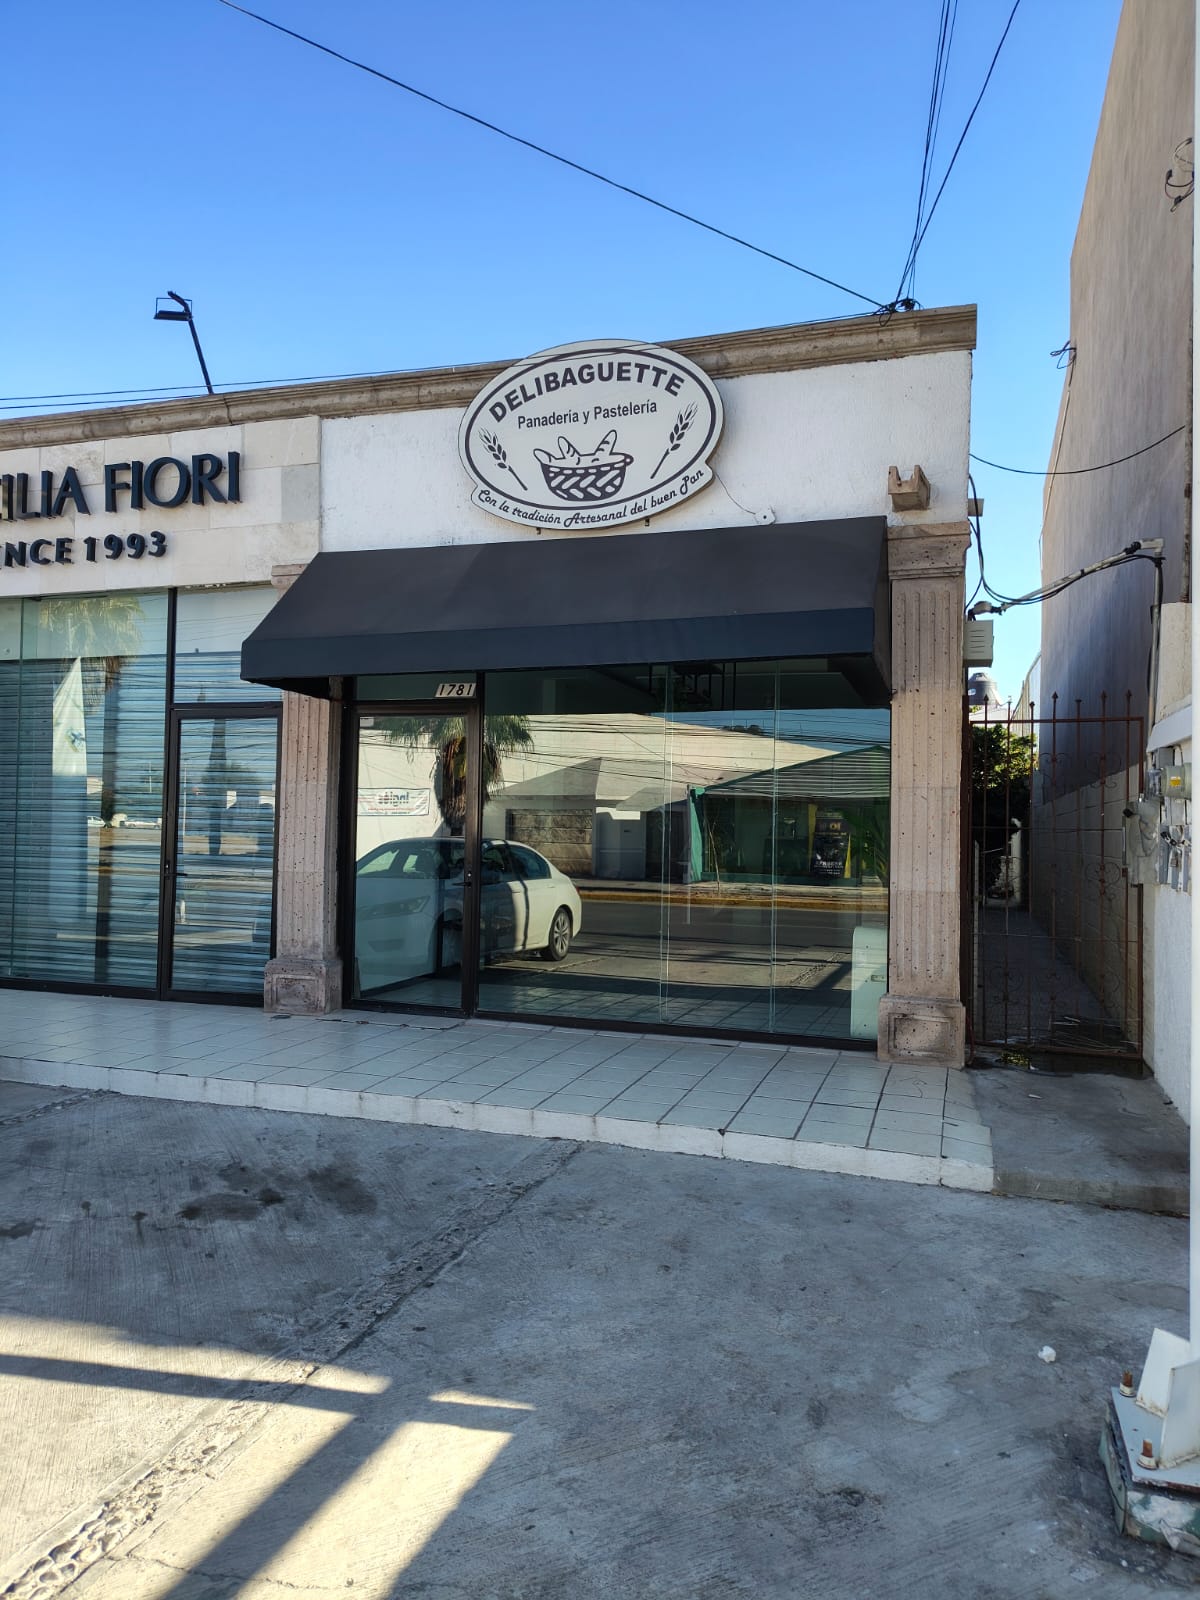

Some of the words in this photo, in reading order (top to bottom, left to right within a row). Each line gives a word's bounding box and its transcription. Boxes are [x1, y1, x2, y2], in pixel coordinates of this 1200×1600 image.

[488, 361, 685, 423] DELIBAGUETTE
[517, 409, 579, 429] Panadería
[583, 410, 590, 424] y
[593, 399, 657, 420] Pastelería
[0, 466, 91, 522] ILIA
[104, 451, 241, 513] FIORI
[477, 489, 498, 507] Con
[498, 500, 509, 512] la
[511, 509, 561, 524] tradición
[563, 504, 627, 528] Artesanal
[630, 498, 648, 515] del
[650, 495, 678, 509] buen
[680, 469, 704, 496] Pan
[0, 537, 74, 568] NCE
[84, 530, 168, 563] 1993
[439, 684, 473, 696] 1781
